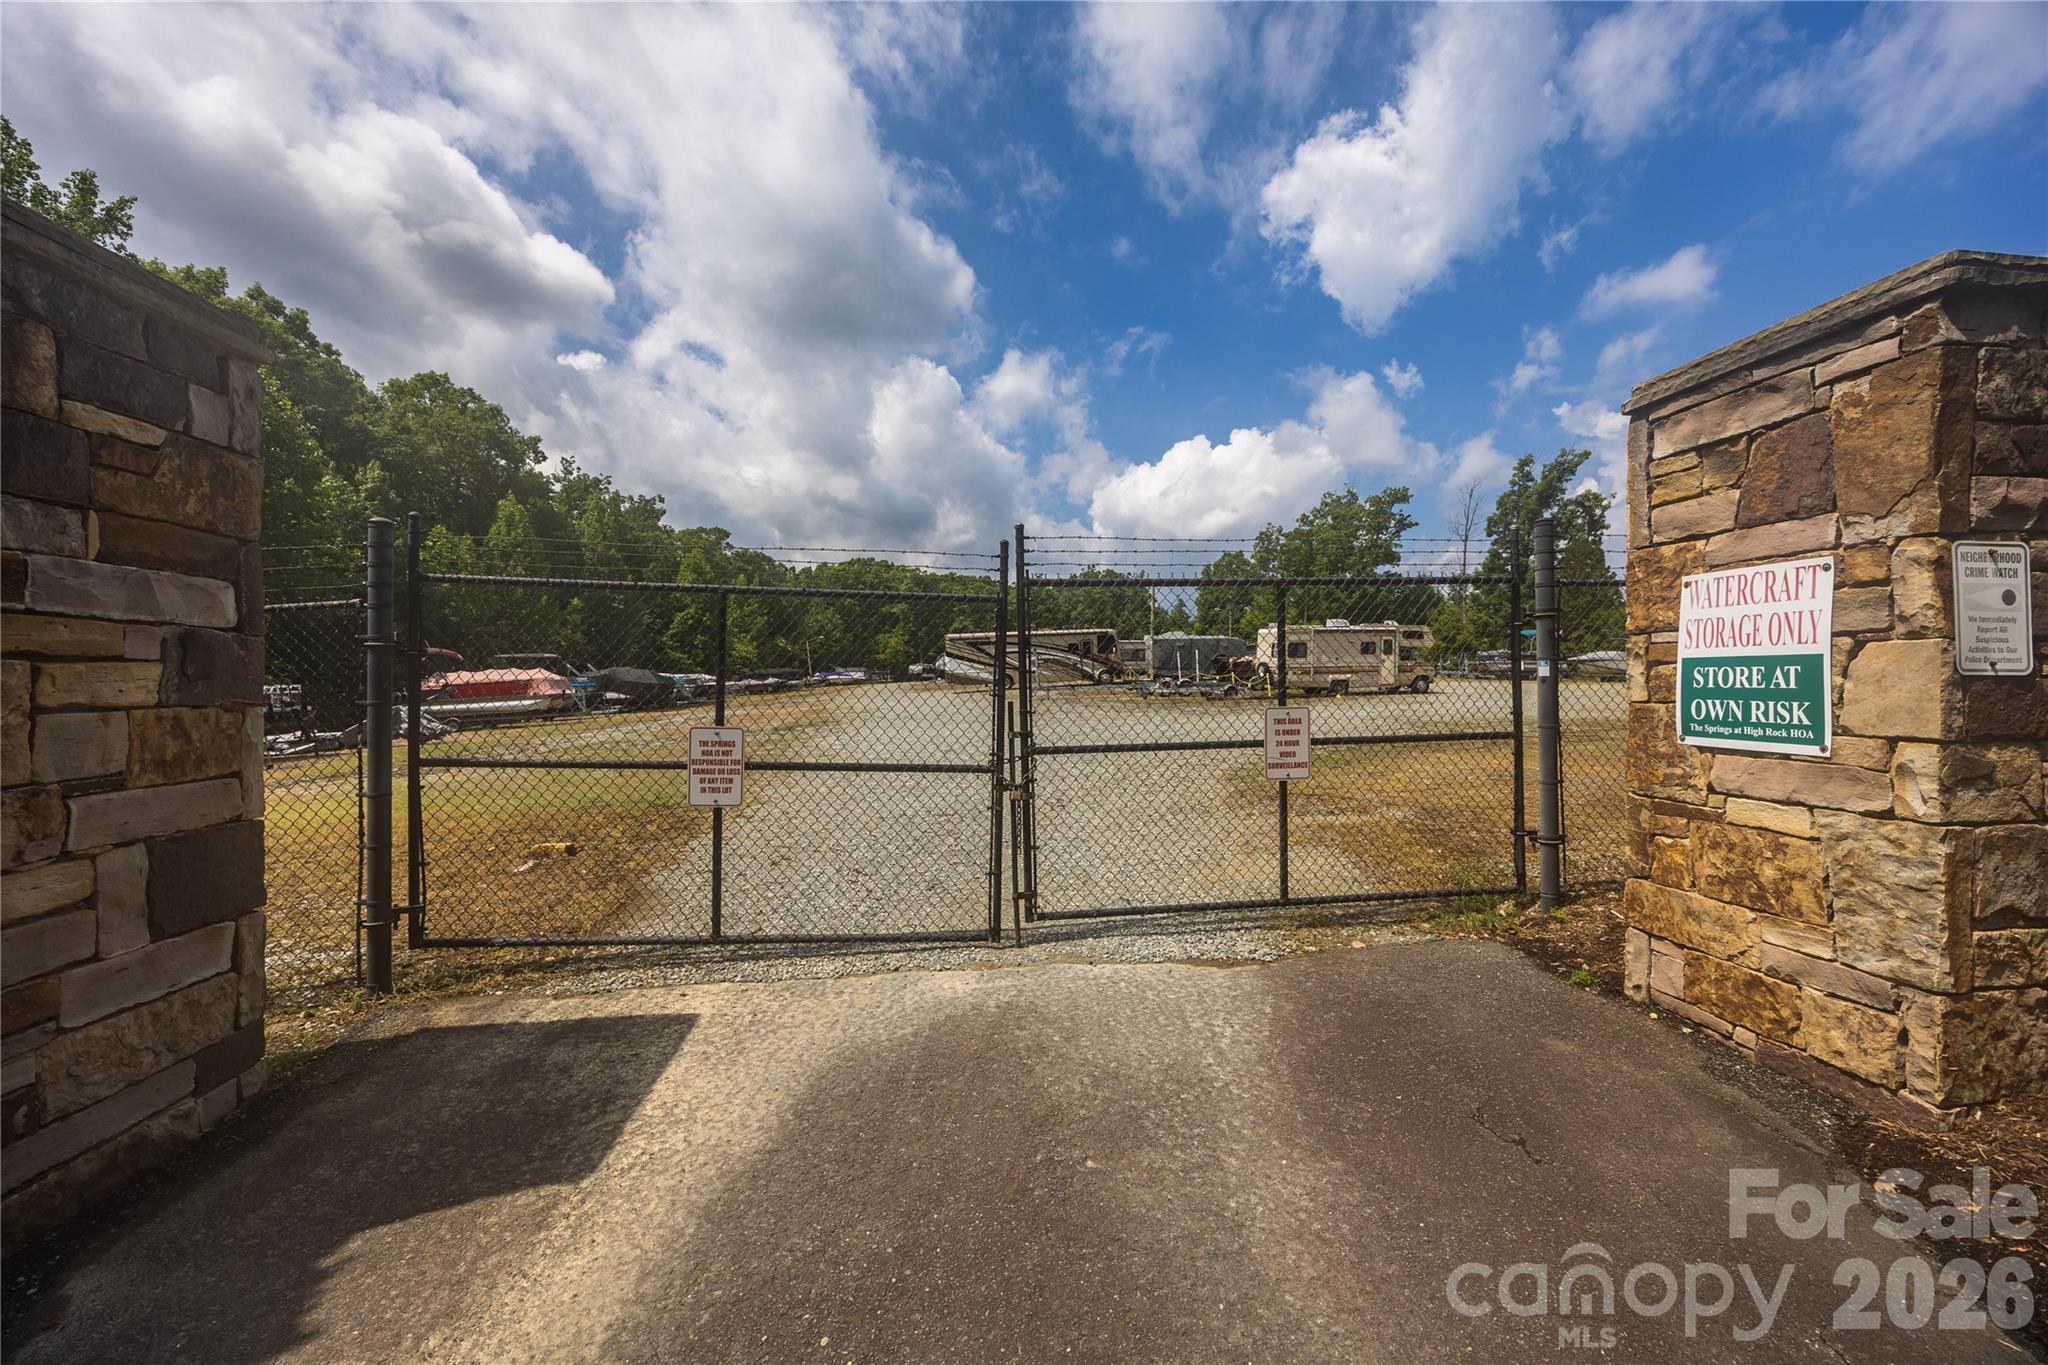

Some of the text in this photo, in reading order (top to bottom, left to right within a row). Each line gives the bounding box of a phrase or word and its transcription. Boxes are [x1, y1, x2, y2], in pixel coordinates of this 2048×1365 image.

[1964, 567, 2018, 579] CRIME WATCH
[1688, 564, 1823, 610] WATERCRAFT
[1979, 616, 2017, 624] Immediately
[1684, 609, 1823, 650] STORAGE ONLY
[1977, 625, 2008, 634] Report All
[1975, 635, 2009, 644] Suspicious
[1965, 656, 1982, 664] Police
[1693, 665, 1801, 689] STORE AT
[1690, 698, 1812, 726] OWN RISK
[1689, 723, 1703, 732] The
[1704, 724, 1733, 735] Springs
[1744, 726, 1763, 737] High
[1765, 727, 1788, 738] Rock
[1790, 729, 1814, 739] HOA
[710, 740, 736, 748] SPRINGS
[701, 749, 733, 757] HOA IS NOT
[700, 786, 732, 794] IN THIS LOT
